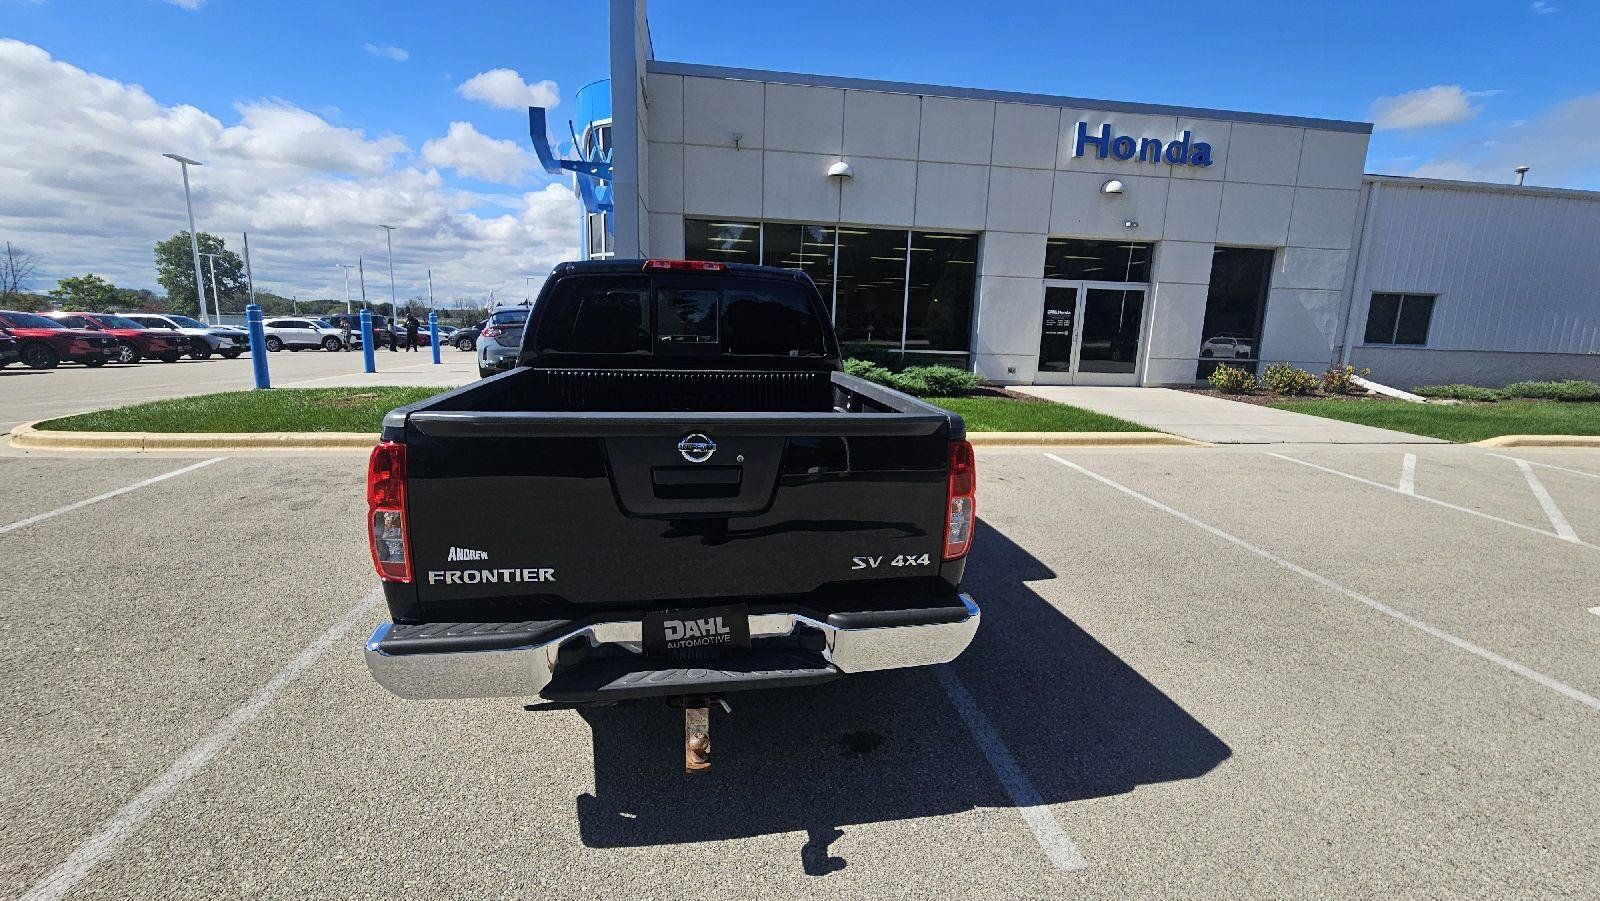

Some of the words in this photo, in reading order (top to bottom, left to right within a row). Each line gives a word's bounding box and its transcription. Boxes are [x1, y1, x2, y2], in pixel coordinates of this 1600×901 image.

[1072, 121, 1213, 167] Honda
[447, 546, 489, 562] ANDREW
[851, 556, 883, 570] SV
[428, 568, 557, 585] FRONTIER
[663, 616, 730, 641] DAHL
[667, 634, 731, 649] AUTOMOTIVE
